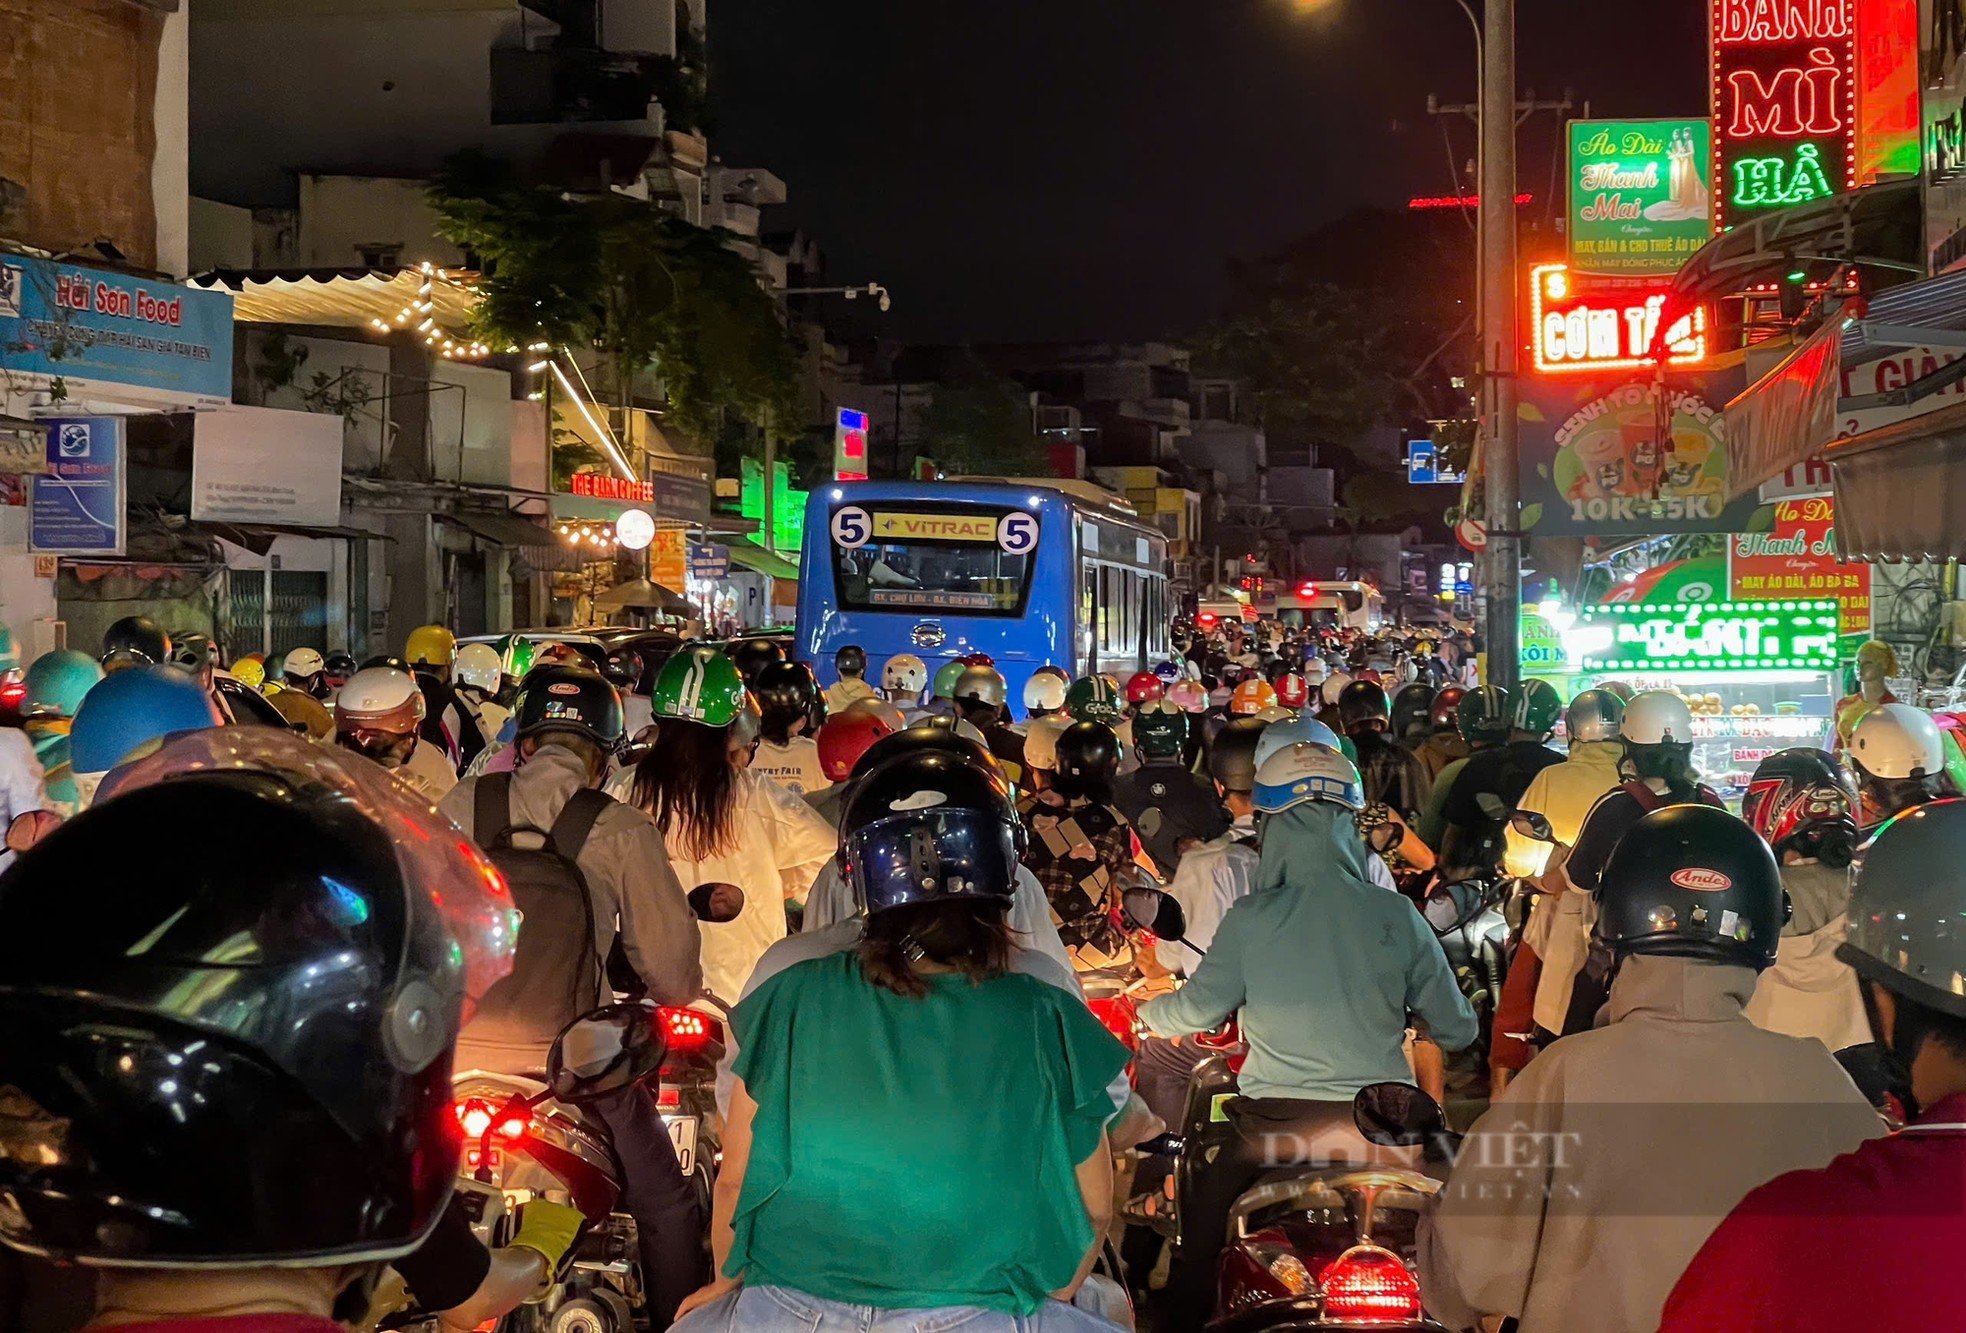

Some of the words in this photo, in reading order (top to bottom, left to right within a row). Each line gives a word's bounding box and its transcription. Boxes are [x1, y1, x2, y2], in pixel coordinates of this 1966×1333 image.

[1728, 47, 1842, 136] MÌ
[1578, 128, 1618, 156] Áo
[1622, 132, 1663, 155] Dài
[1580, 162, 1659, 191] Thanh
[1580, 193, 1642, 221] Mai
[1575, 240, 1597, 254] MAY,
[1600, 237, 1618, 253] BÁN
[1620, 240, 1627, 252] &
[1629, 240, 1648, 252] CHO
[1650, 236, 1673, 252] THUÊ
[1675, 236, 1689, 251] ÁO
[56, 272, 90, 311] Hải
[95, 280, 131, 318] Sơn
[136, 288, 182, 327] Food
[1544, 305, 1619, 361] CƠM
[1554, 397, 1609, 448] SINH
[571, 474, 591, 496] THE
[620, 479, 654, 501] COFFEE
[839, 514, 864, 543] 5
[1005, 519, 1031, 550] 5
[1736, 529, 1807, 558] Thanh
[1742, 576, 1765, 589] MAY
[1768, 573, 1782, 588] ÁO
[1809, 573, 1824, 588] ÁO
